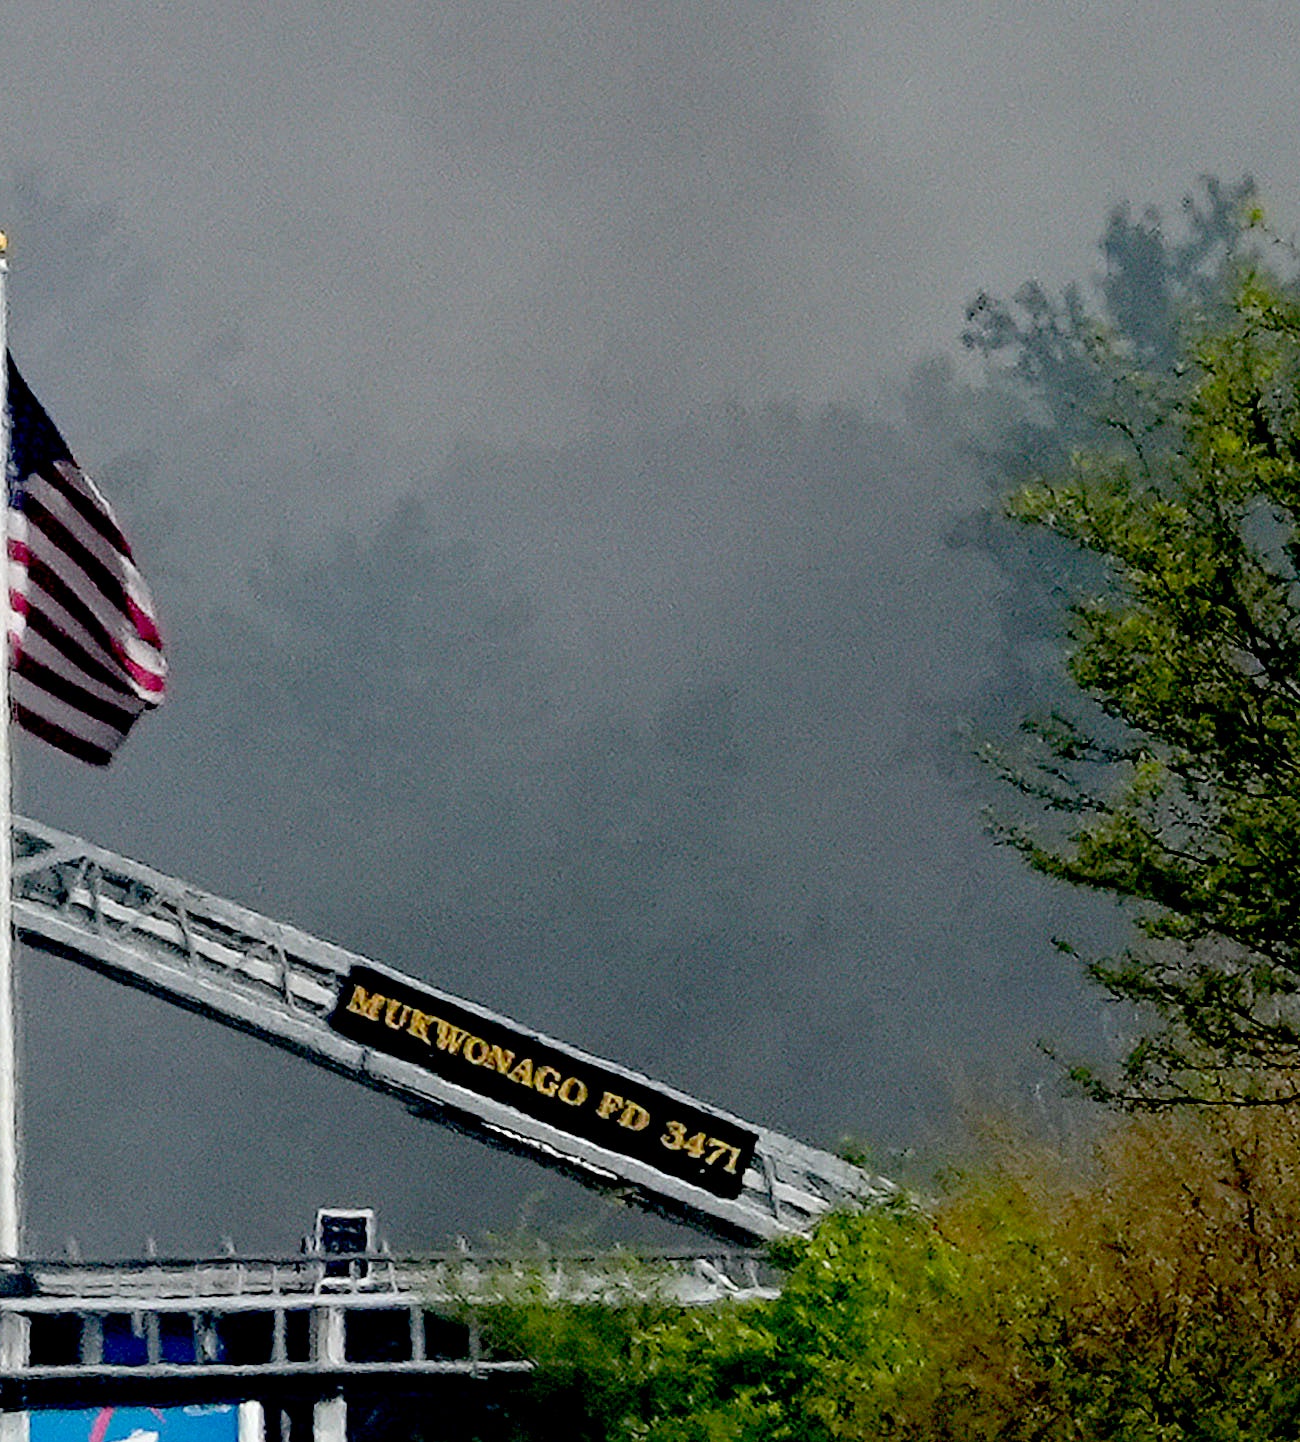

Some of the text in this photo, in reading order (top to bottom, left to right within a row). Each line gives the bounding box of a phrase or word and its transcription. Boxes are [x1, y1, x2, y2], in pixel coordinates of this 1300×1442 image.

[346, 985, 742, 1175] MUKWONAGO FD 3471
